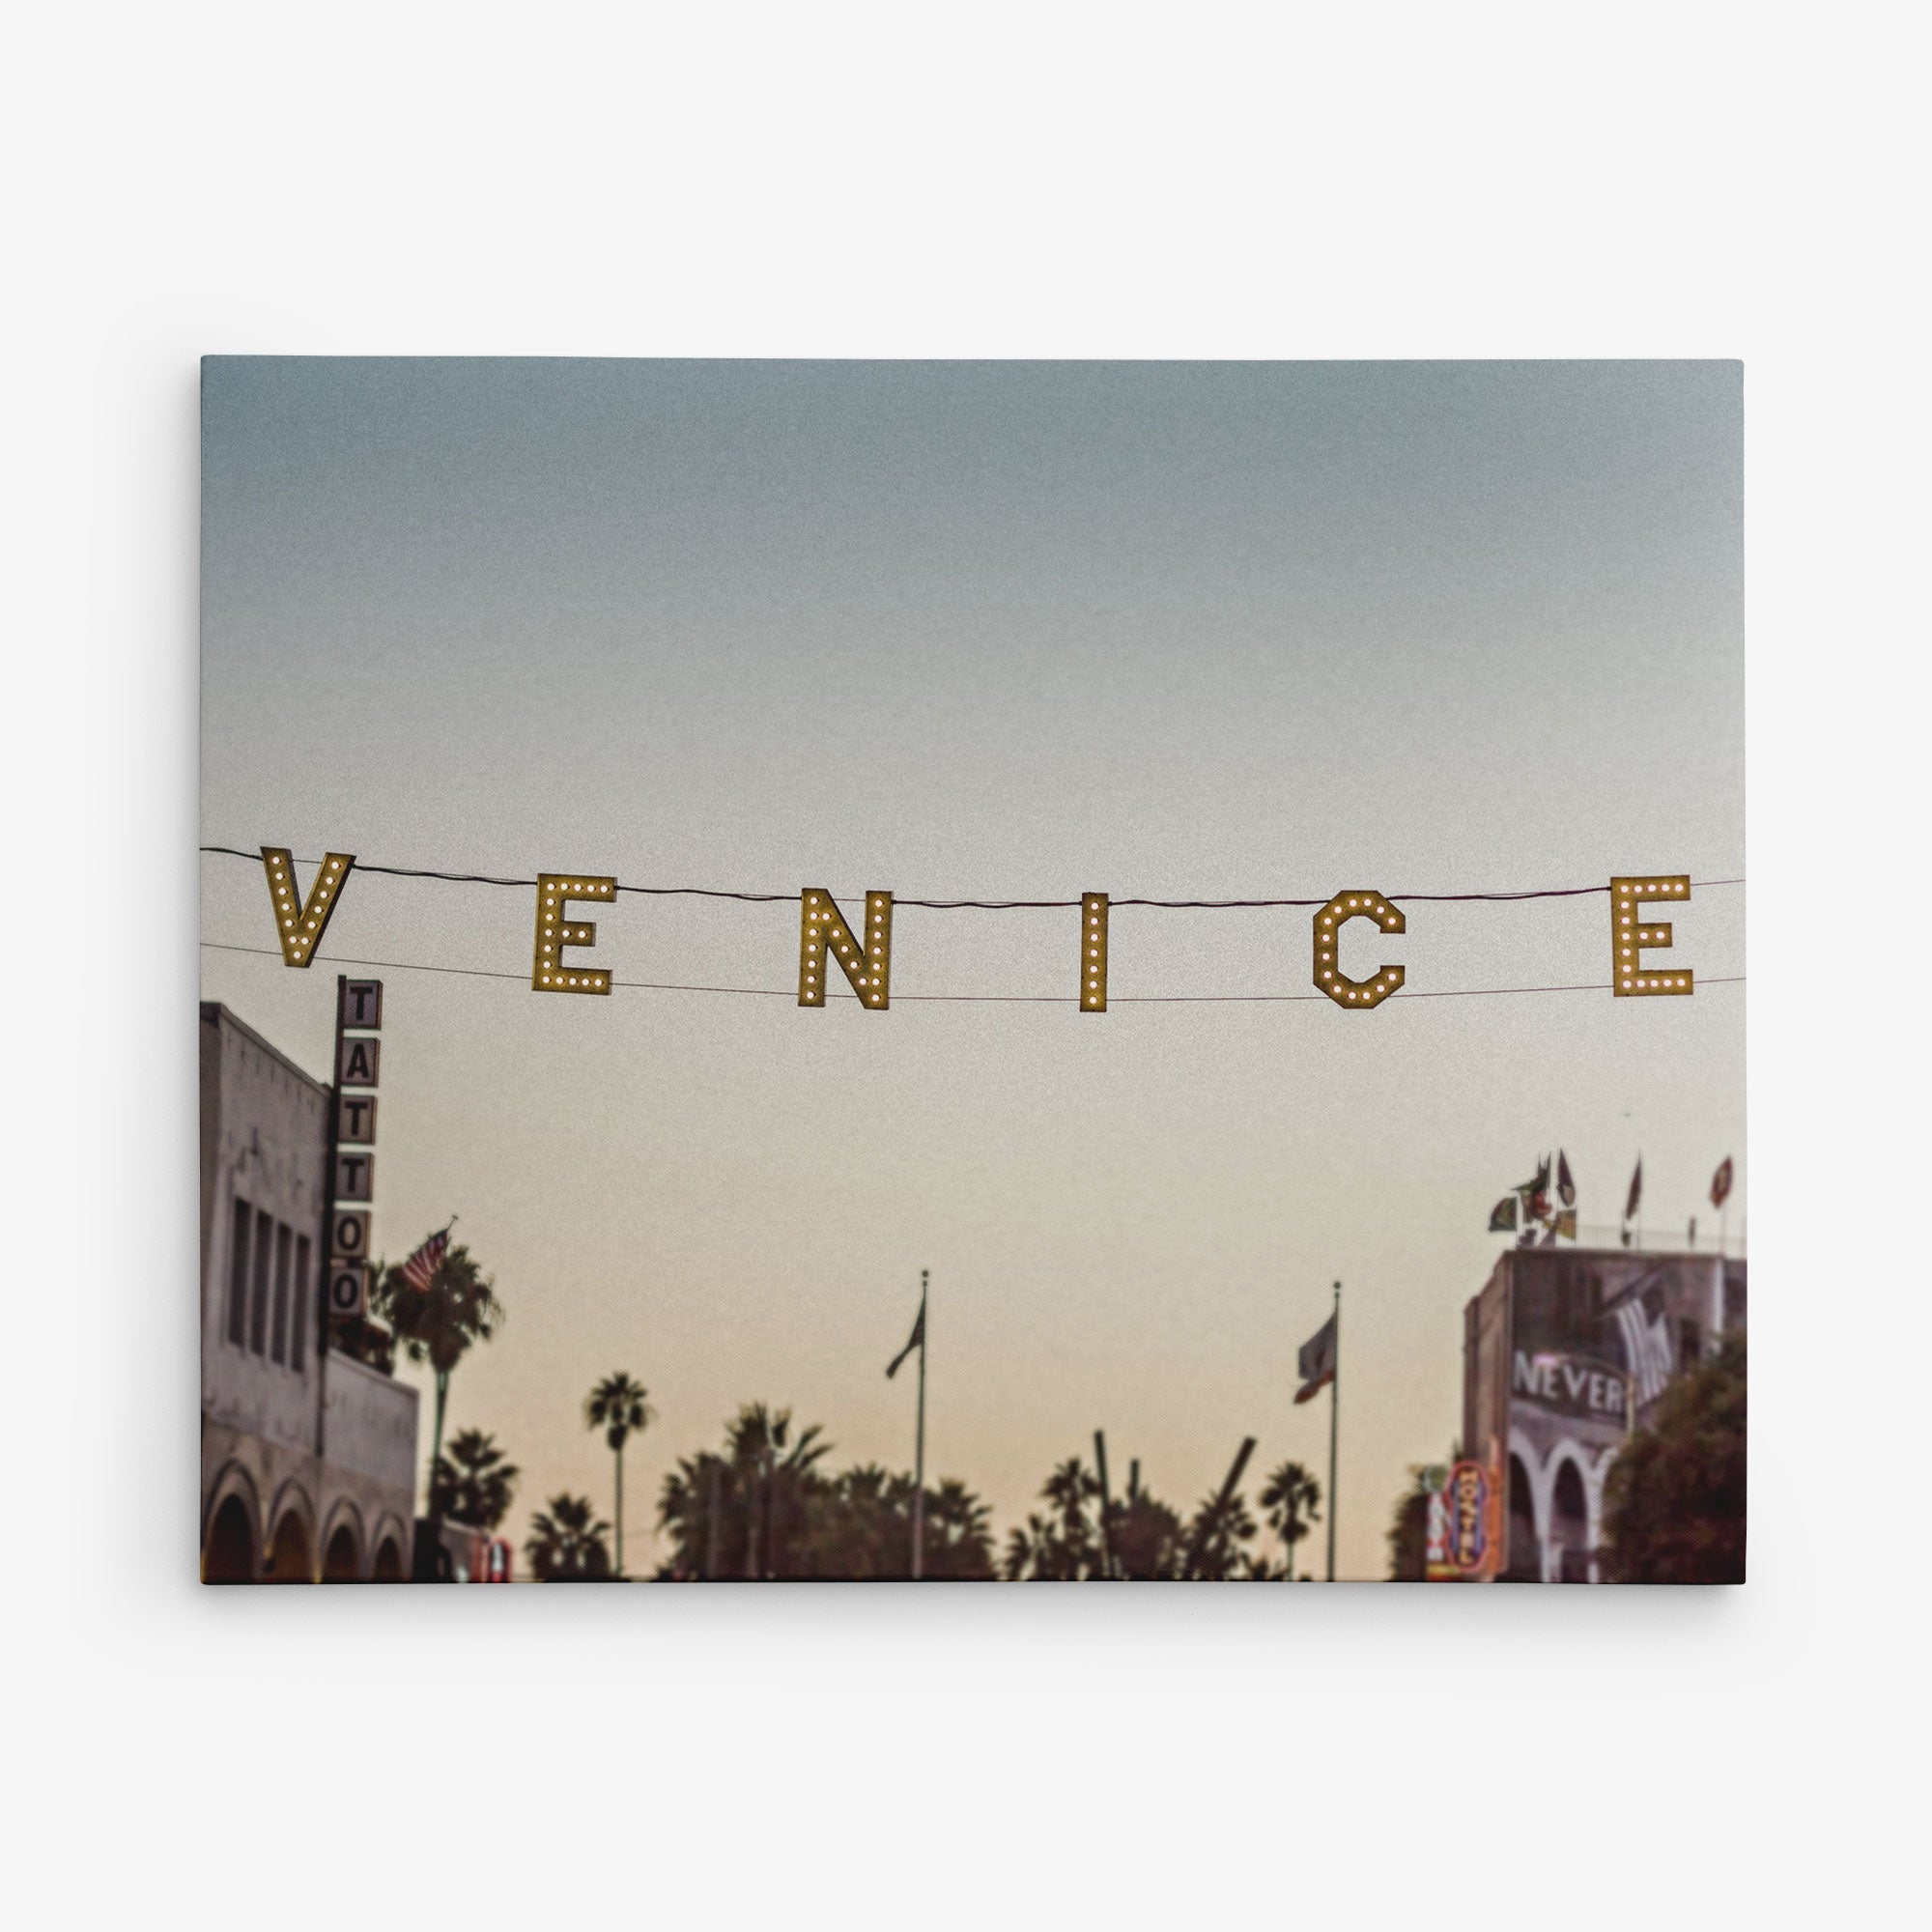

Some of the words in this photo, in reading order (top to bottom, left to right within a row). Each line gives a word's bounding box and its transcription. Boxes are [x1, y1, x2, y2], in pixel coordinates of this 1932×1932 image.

[259, 846, 1694, 1012] VENICE
[333, 985, 374, 1309] TATTOO
[1514, 1350, 1623, 1412] NEVER
